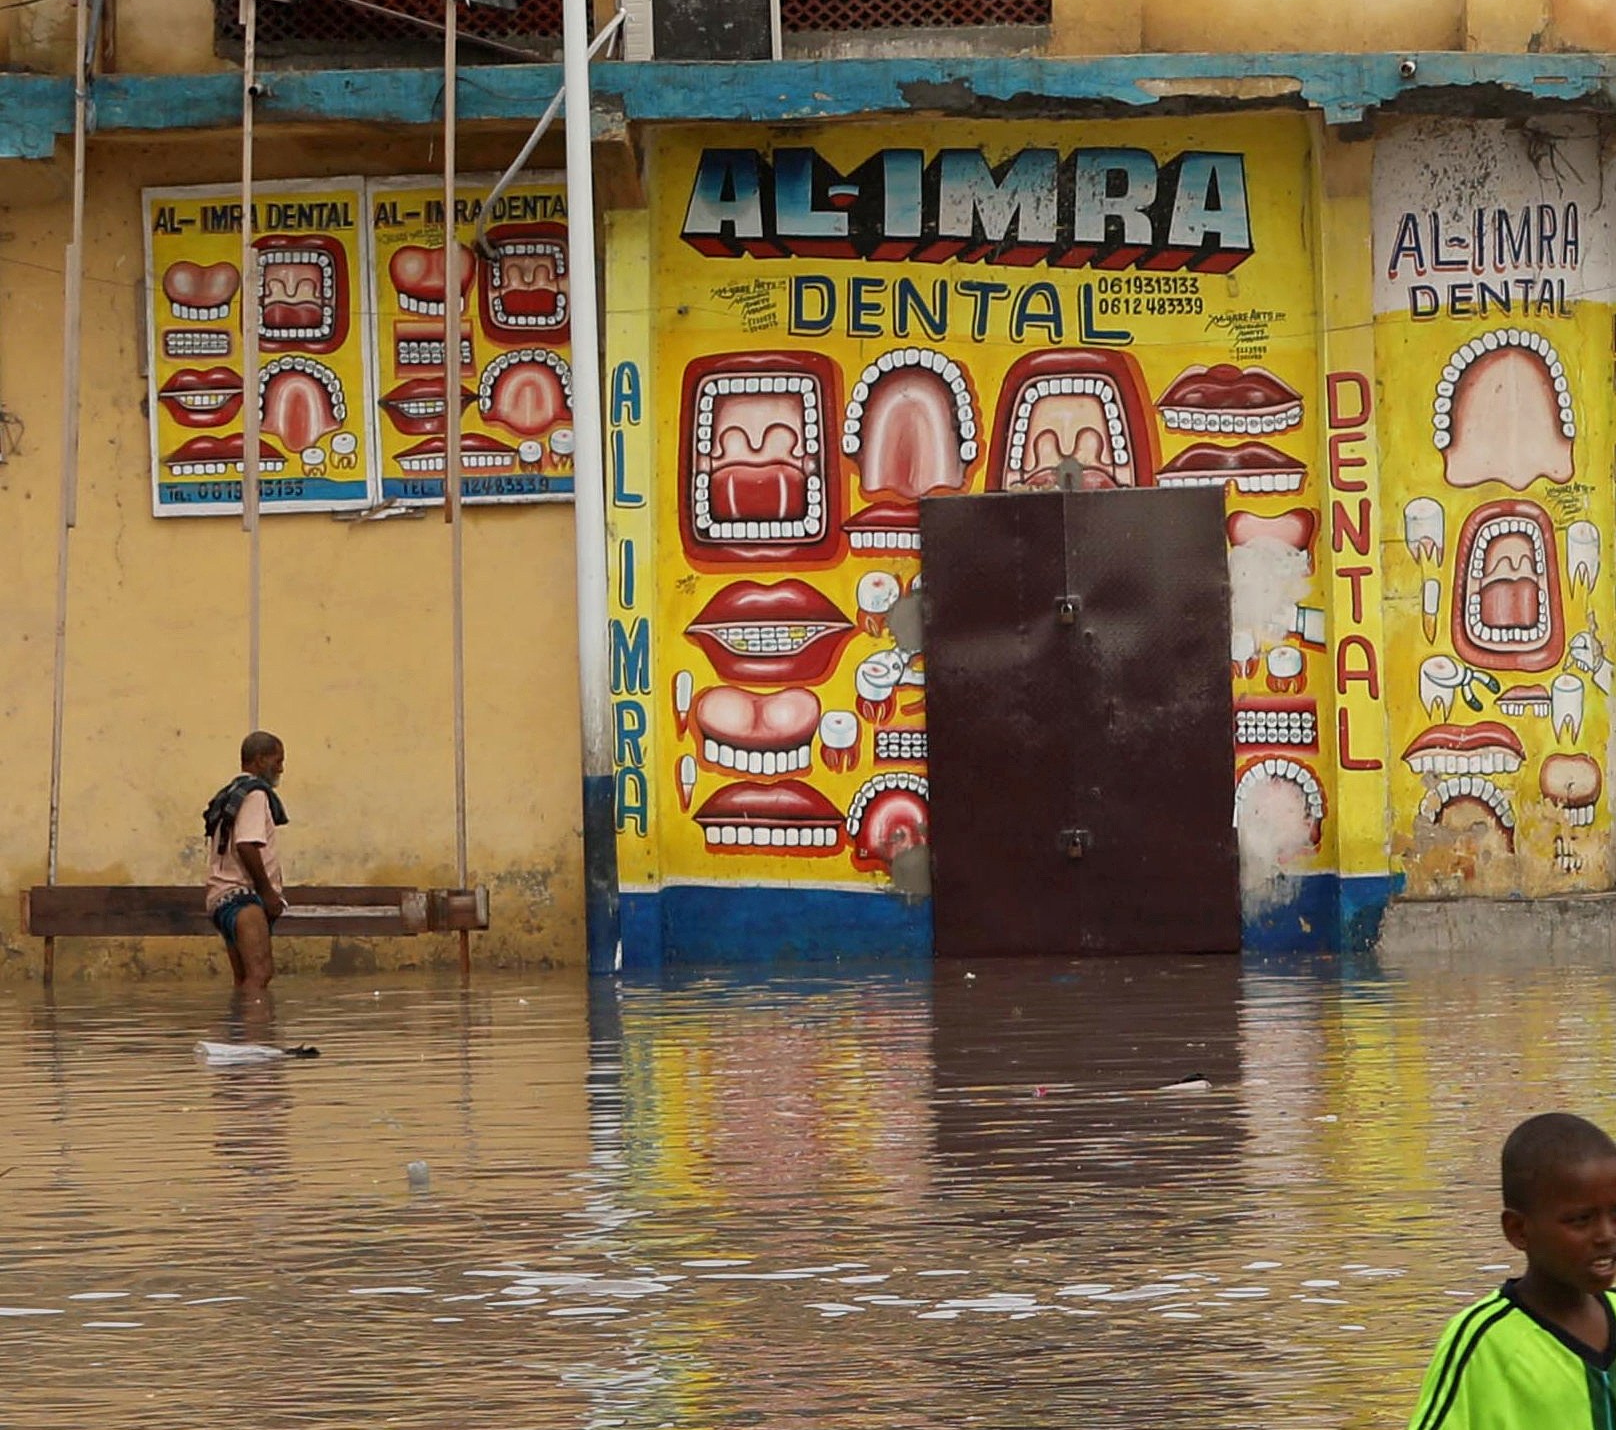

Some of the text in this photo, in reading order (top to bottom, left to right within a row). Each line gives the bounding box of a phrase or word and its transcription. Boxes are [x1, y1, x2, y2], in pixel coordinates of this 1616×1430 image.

[266, 201, 354, 230] DENTAL
[490, 193, 569, 221] DENTA
[681, 147, 1254, 271] AL-IMRA
[1387, 201, 1580, 280] AL-IMRA
[788, 274, 1135, 347] DENTAL
[1097, 275, 1201, 295] 0619313133
[1408, 277, 1576, 320] DENTAL
[1325, 370, 1384, 771] DENTAL
